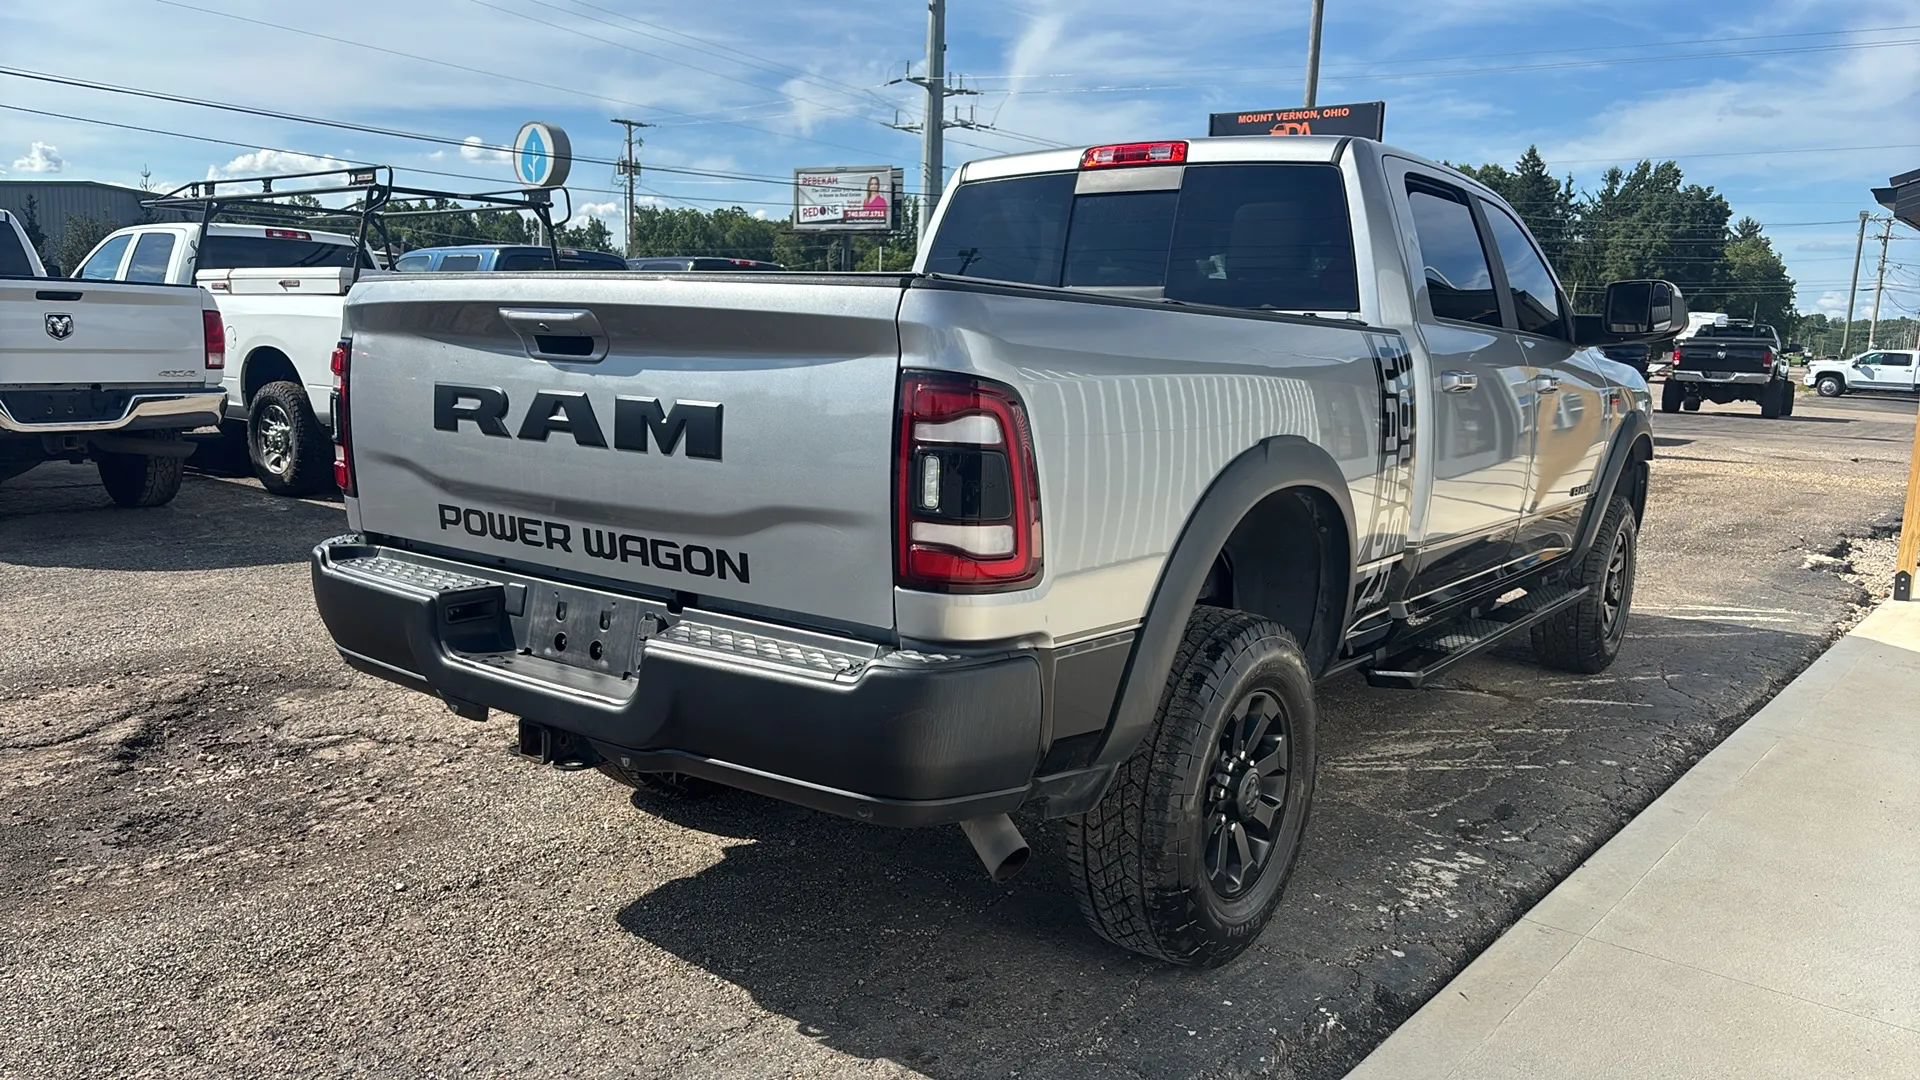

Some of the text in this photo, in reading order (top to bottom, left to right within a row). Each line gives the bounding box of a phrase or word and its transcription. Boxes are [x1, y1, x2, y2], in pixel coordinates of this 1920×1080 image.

[1238, 108, 1350, 124] MOUNT VERNON, OHIO
[802, 176, 838, 186] REBEKAH
[434, 381, 724, 462] RAM
[438, 503, 750, 584] POWER WAGON
